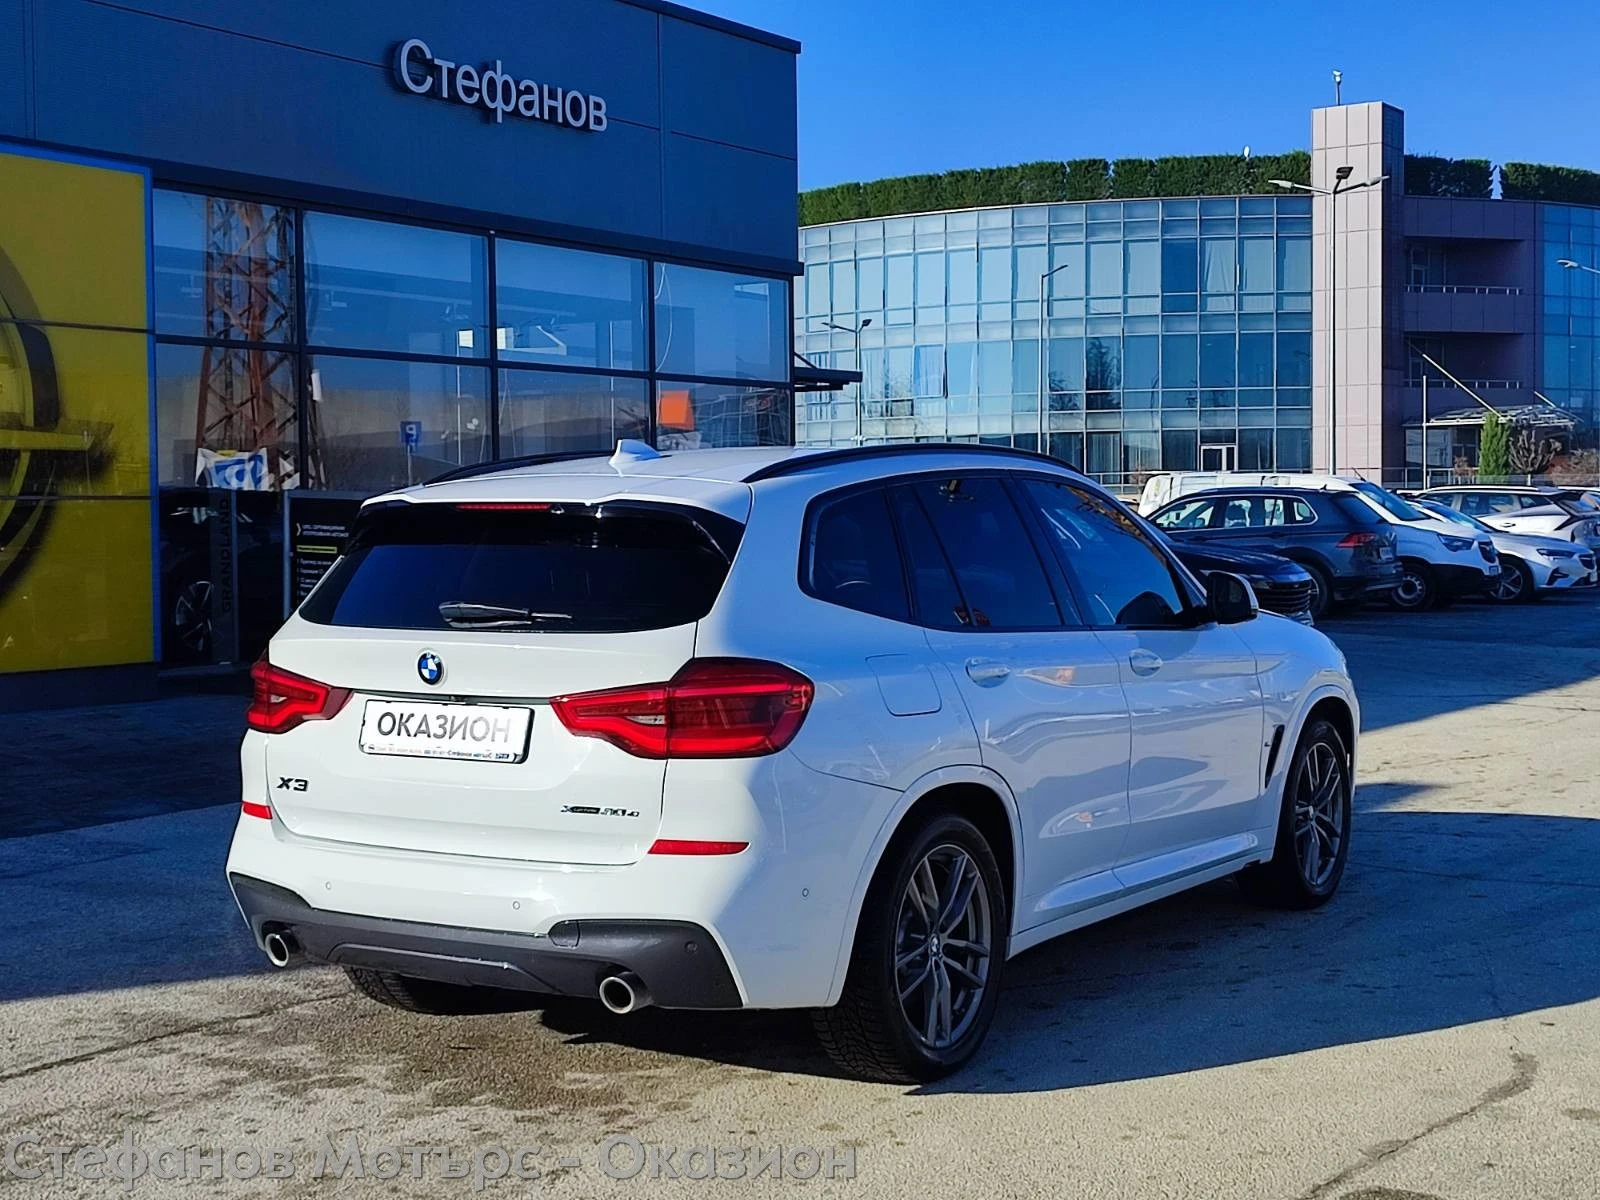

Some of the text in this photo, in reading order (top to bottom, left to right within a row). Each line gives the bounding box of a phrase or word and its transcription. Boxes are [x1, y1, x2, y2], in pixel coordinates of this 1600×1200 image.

[399, 38, 608, 132] Стефанов
[218, 498, 231, 613] GRANDLAND
[377, 711, 512, 743] ОКАЗИОН
[276, 776, 308, 792] X3
